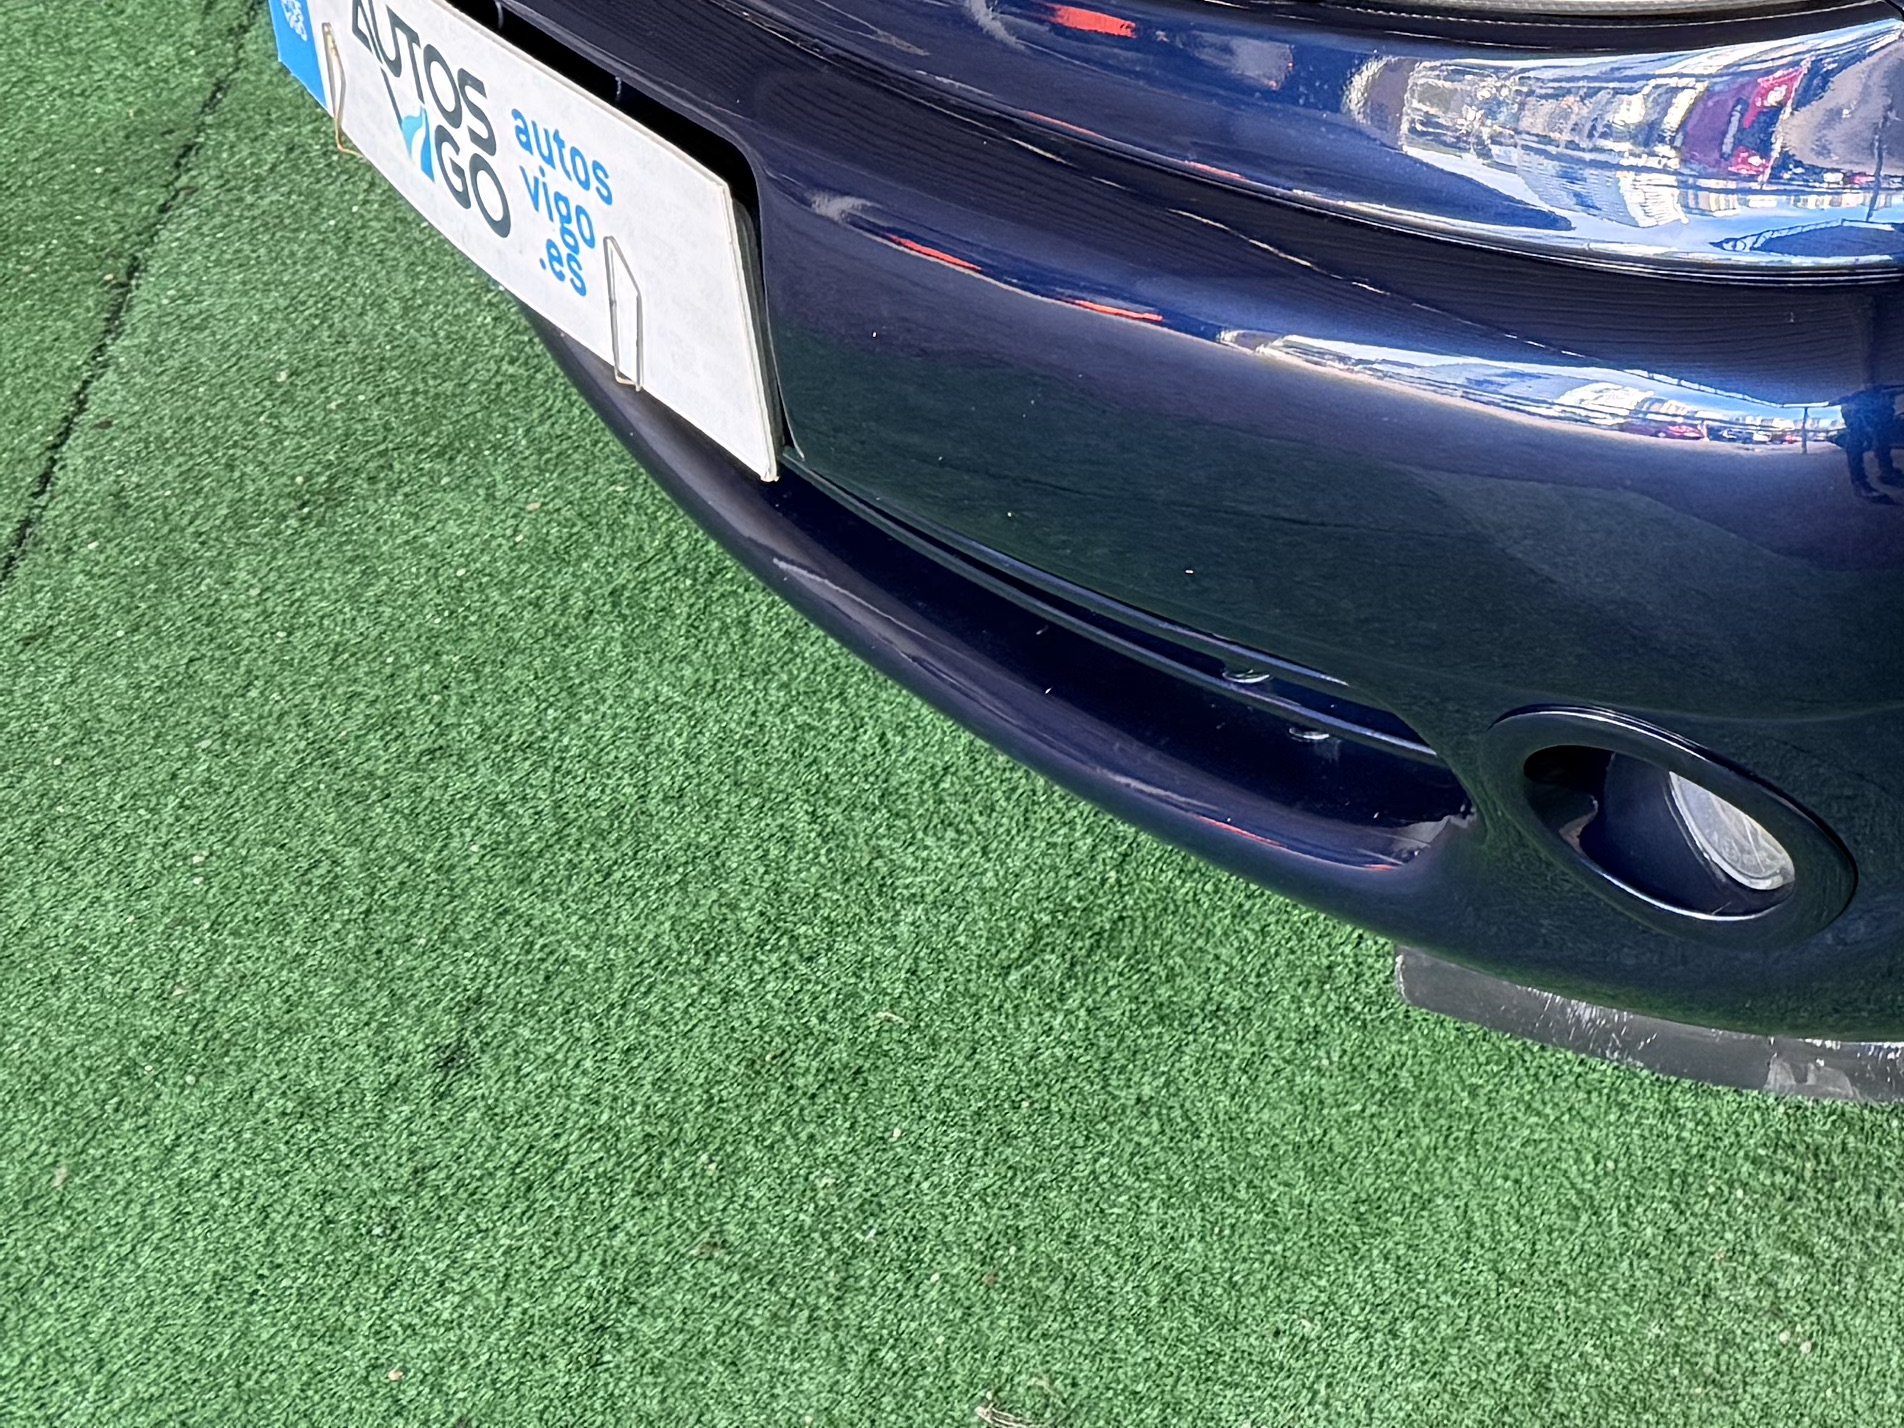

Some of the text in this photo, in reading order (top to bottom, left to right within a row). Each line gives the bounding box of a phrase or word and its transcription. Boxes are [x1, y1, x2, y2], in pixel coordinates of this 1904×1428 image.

[379, 66, 512, 239] VIGO
[511, 108, 613, 205] autos
[519, 164, 596, 256] vigo
[539, 238, 588, 297] .es
